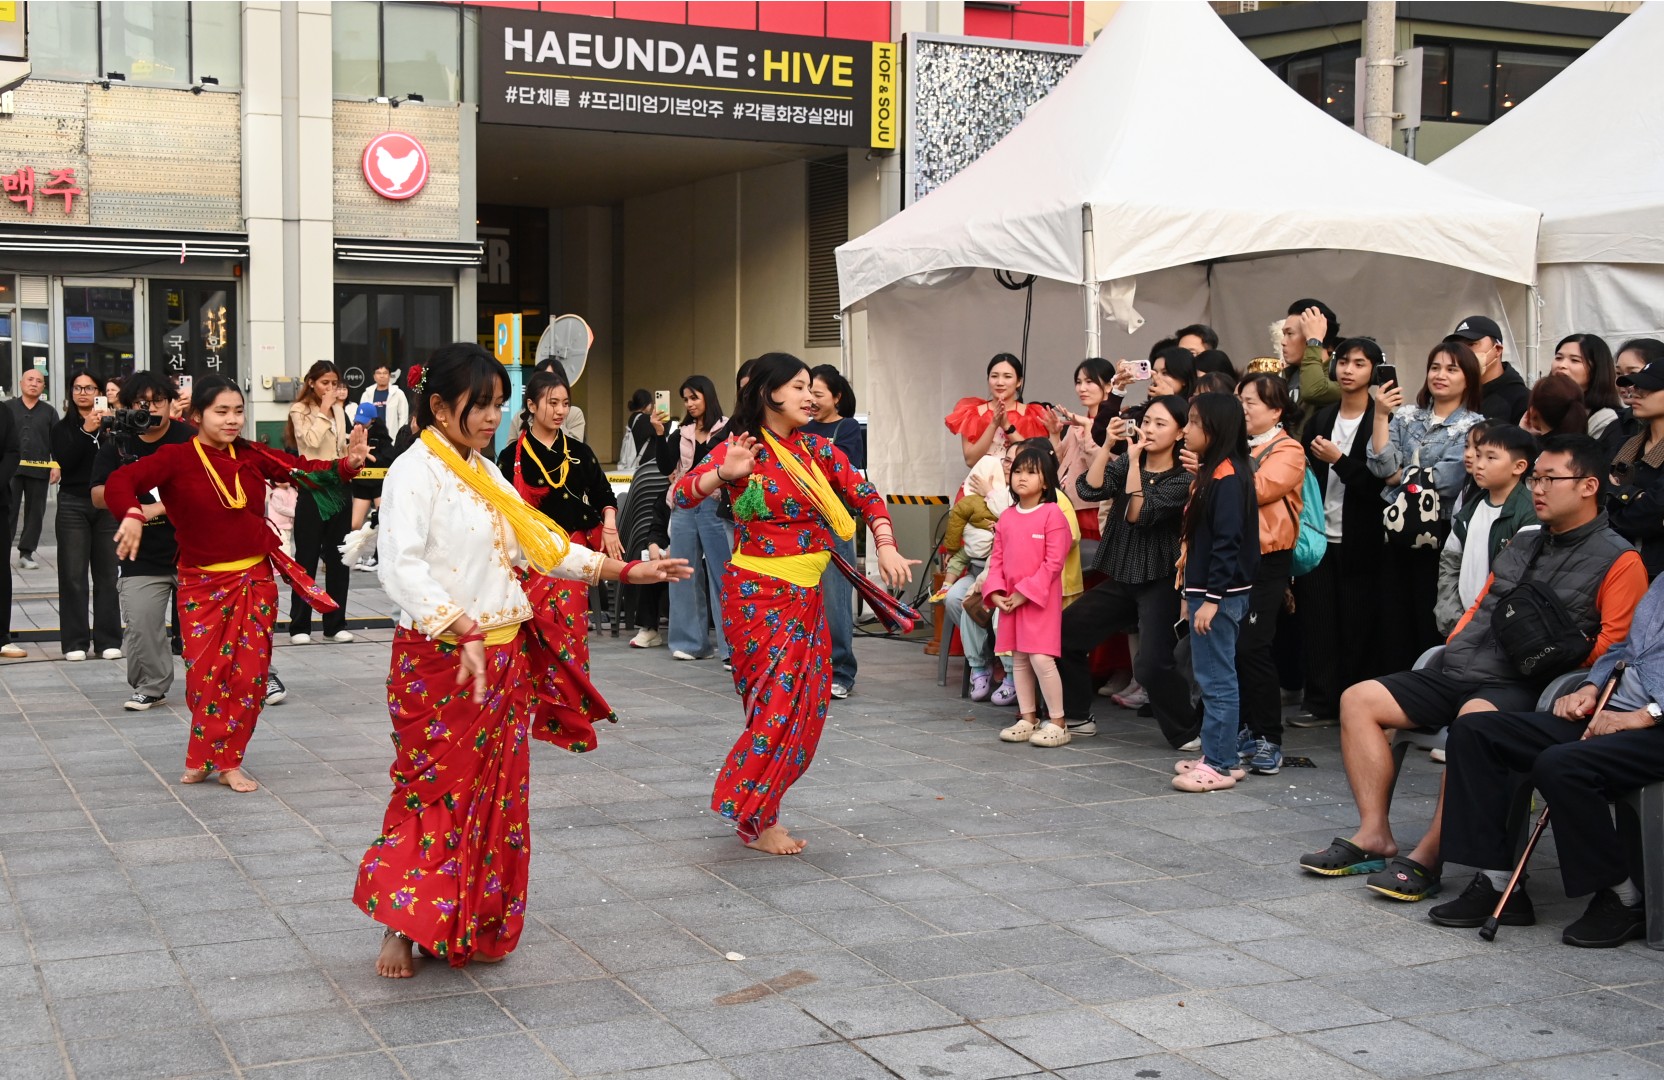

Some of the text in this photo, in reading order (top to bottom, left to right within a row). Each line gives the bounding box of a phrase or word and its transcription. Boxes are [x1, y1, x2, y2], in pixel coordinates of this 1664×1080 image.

[504, 27, 738, 79] HAEUNDAE
[763, 49, 854, 87] HIVE
[505, 86, 853, 127] #단체룸 #프리미엄기본안주 #각룸화장실완비
[878, 47, 891, 143] HOF & SOJU
[1, 166, 82, 214] 맥주
[498, 323, 507, 354] P
